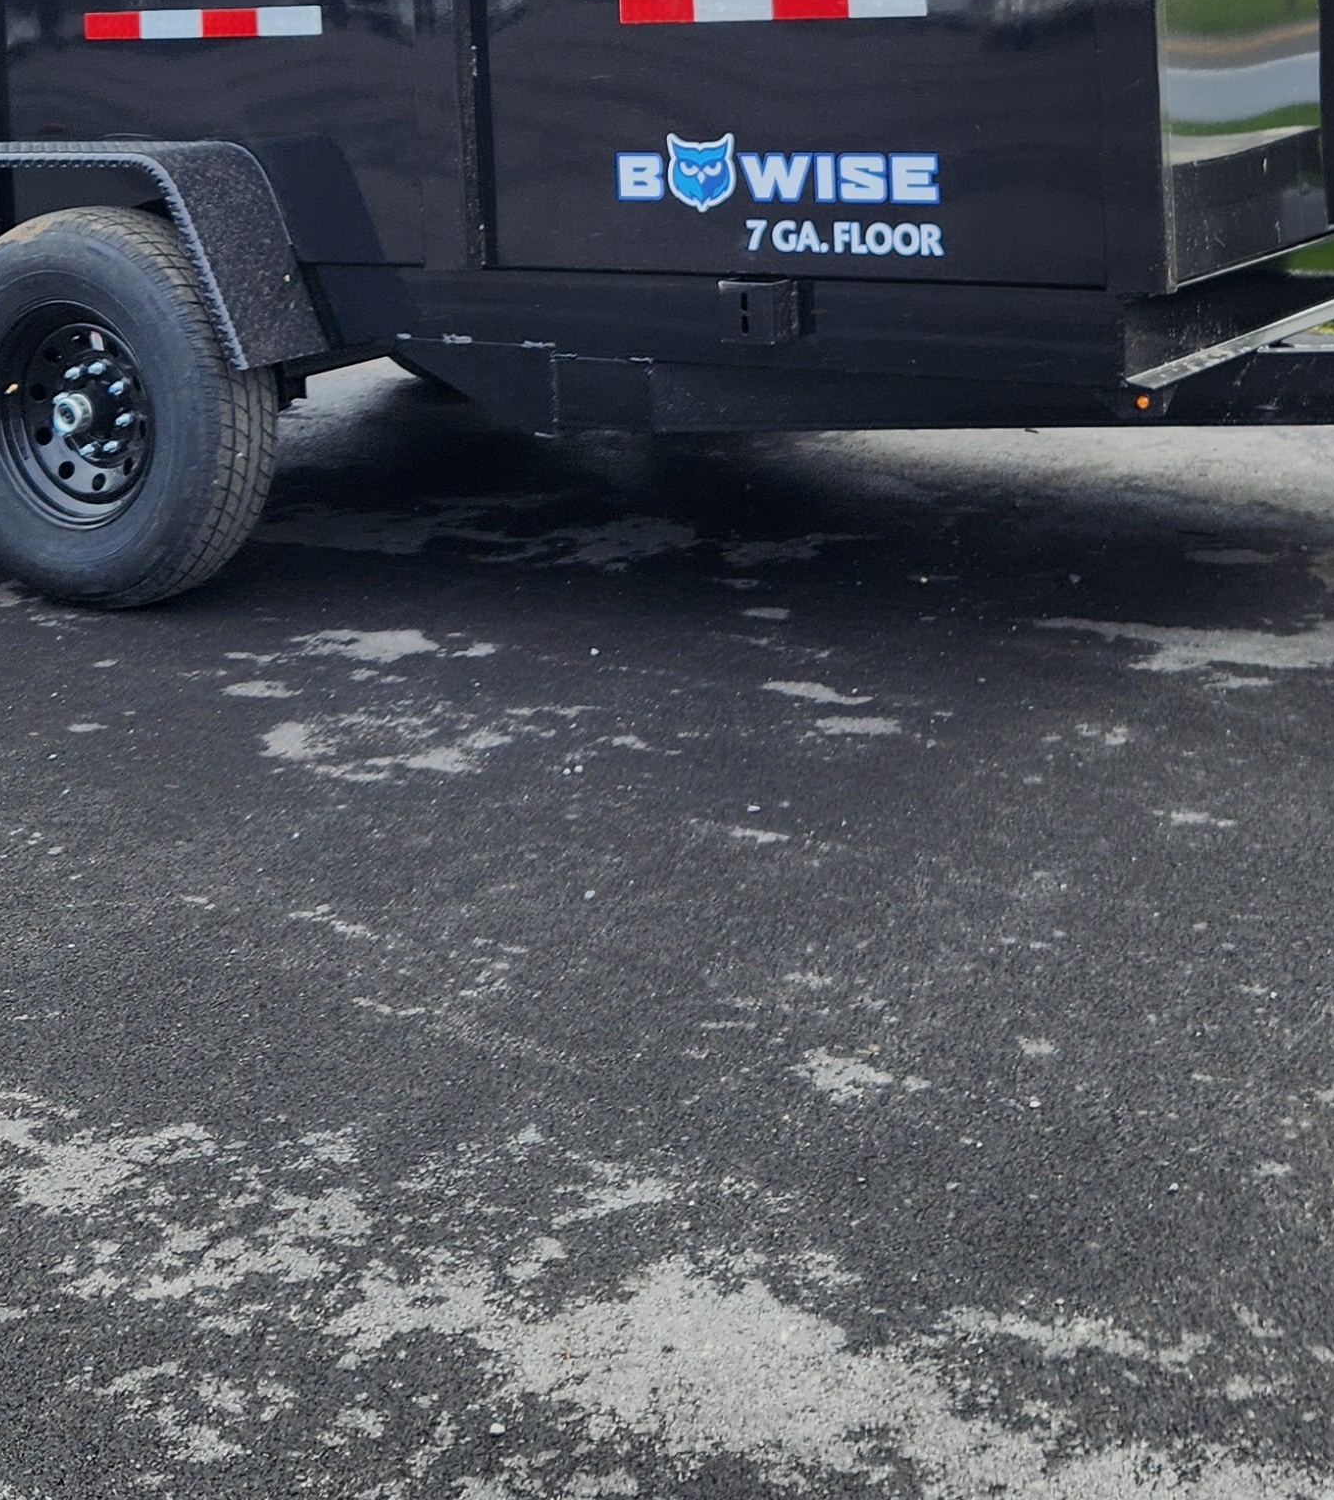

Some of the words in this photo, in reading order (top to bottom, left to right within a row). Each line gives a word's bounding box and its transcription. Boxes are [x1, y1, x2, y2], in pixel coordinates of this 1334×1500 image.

[745, 219, 767, 250] 7
[772, 219, 829, 253] GA.
[833, 221, 944, 256] FLOOR
